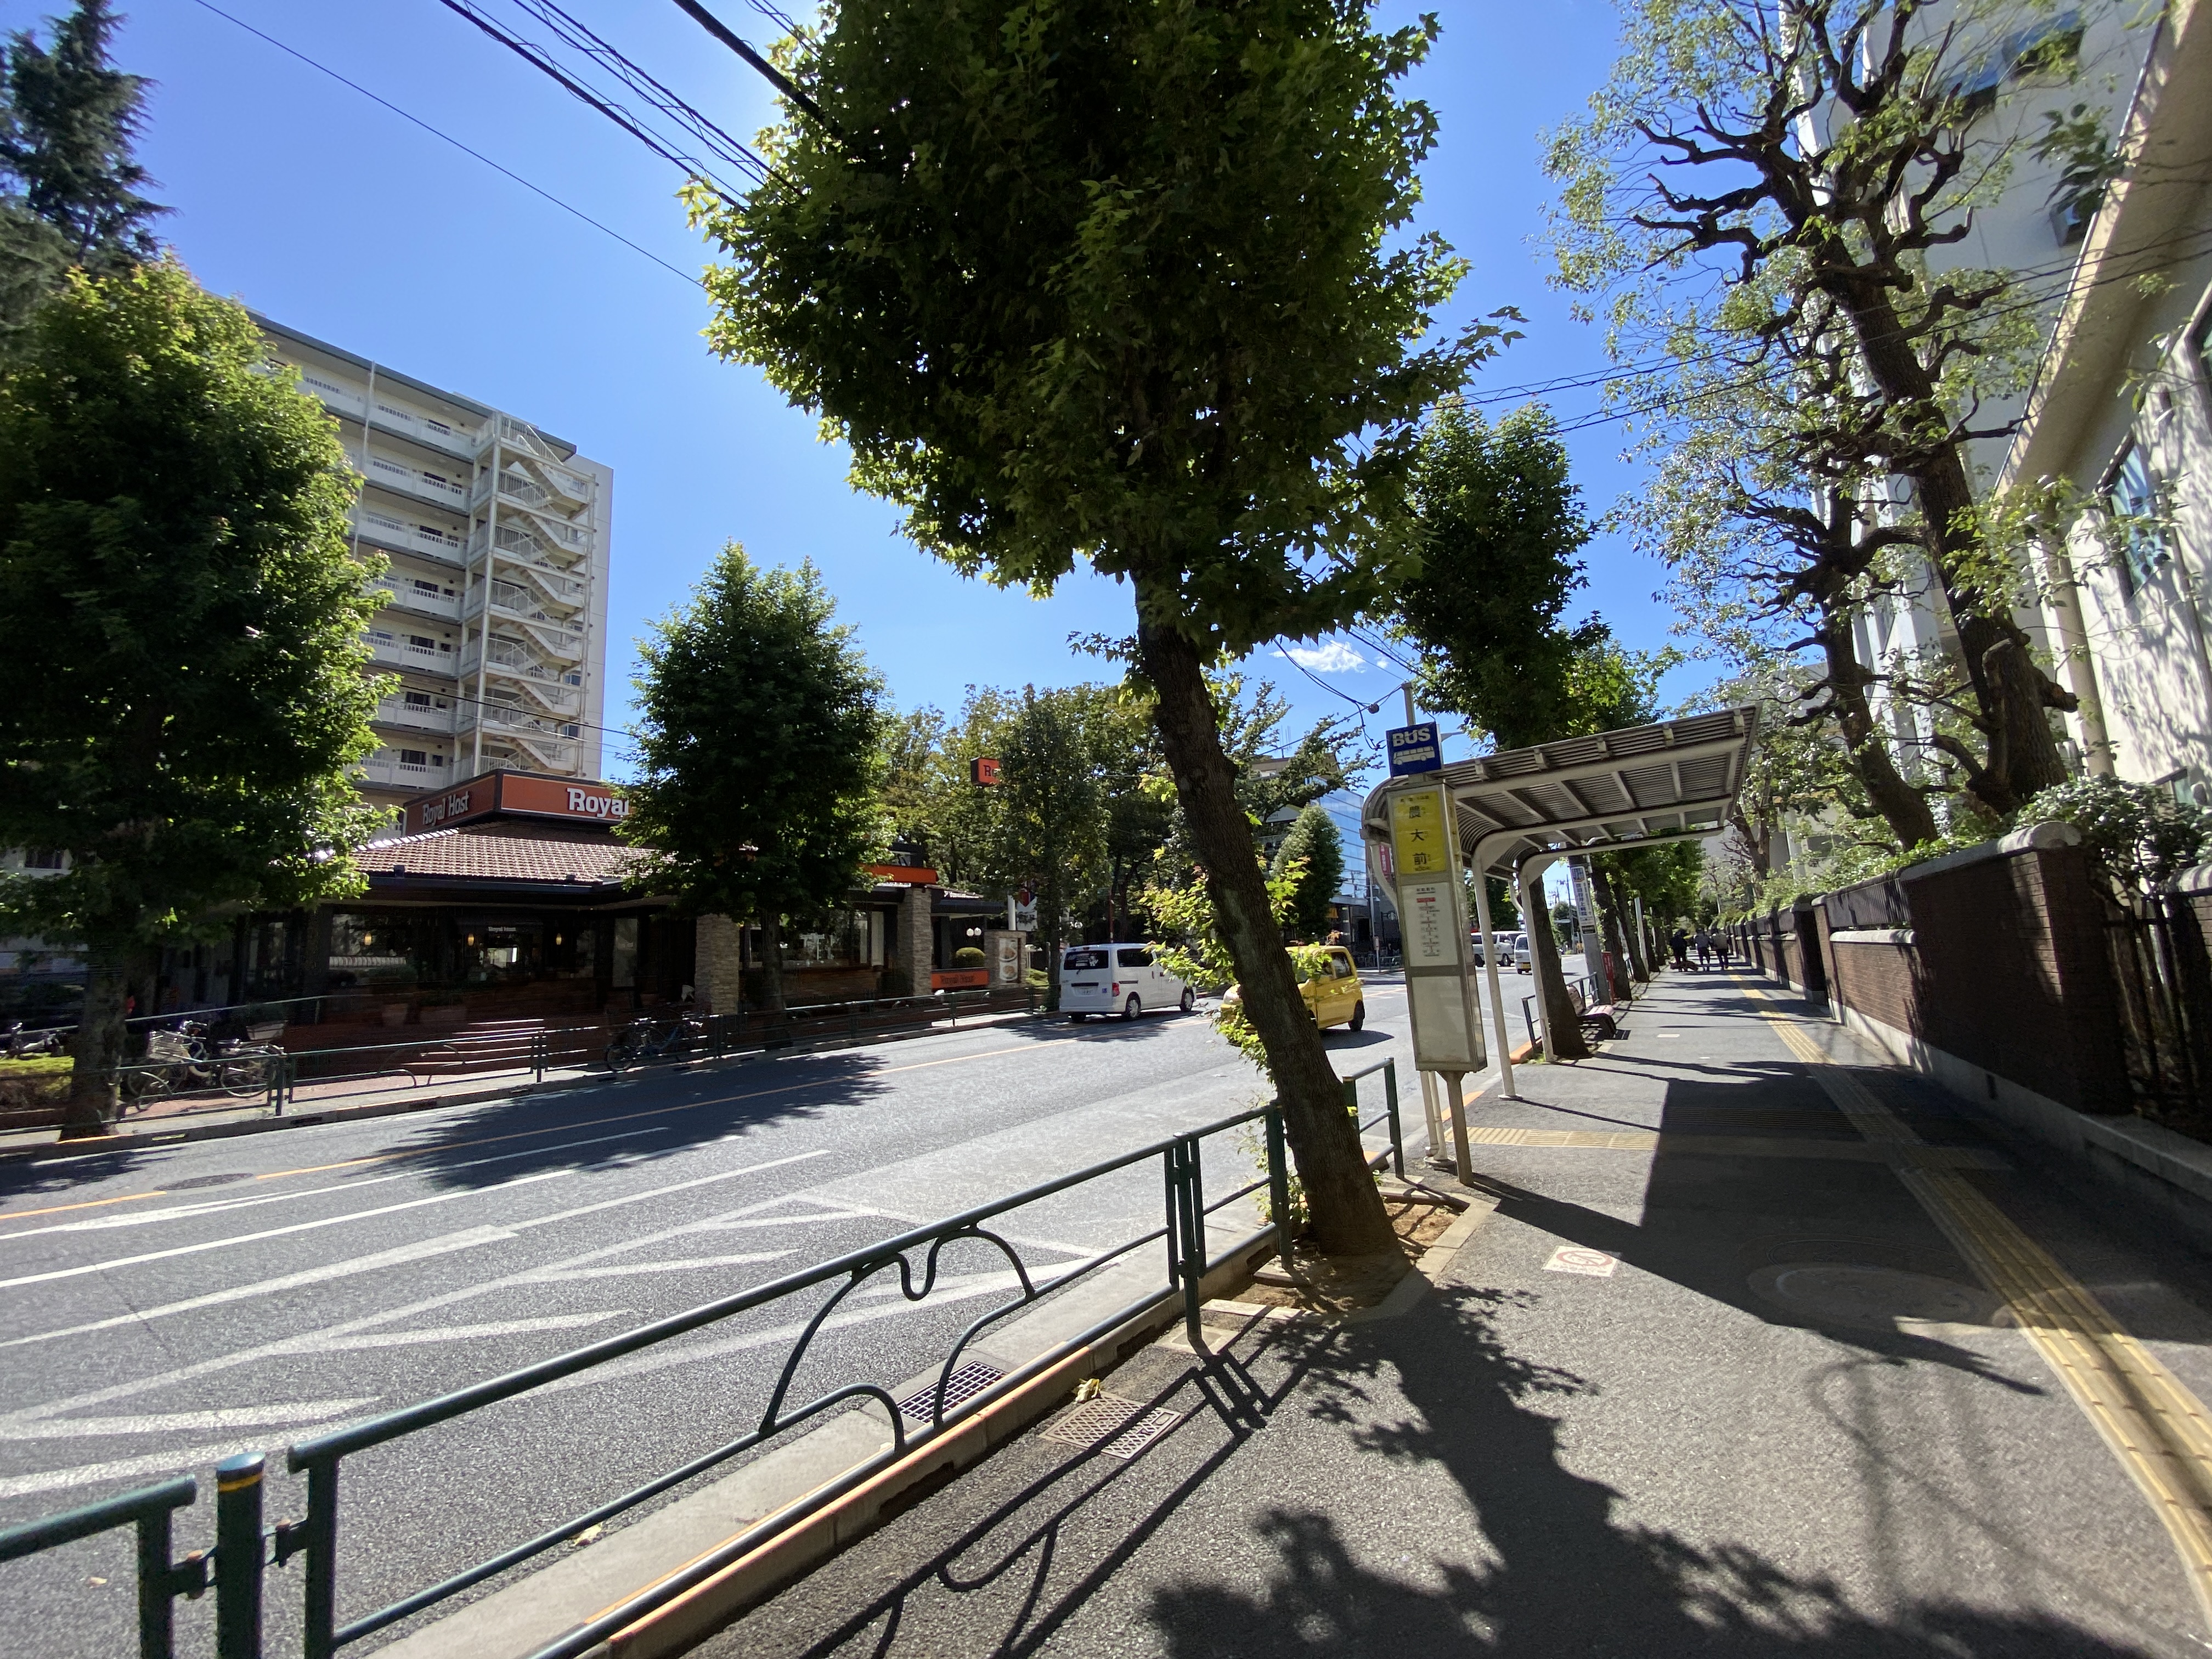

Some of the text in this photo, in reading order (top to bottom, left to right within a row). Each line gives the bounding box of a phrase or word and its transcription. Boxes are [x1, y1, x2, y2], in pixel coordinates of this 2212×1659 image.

[1392, 727, 1431, 747] BUS
[423, 791, 469, 826] Royal Host
[567, 787, 629, 817] Royal
[1408, 805, 1426, 865] 農大前
